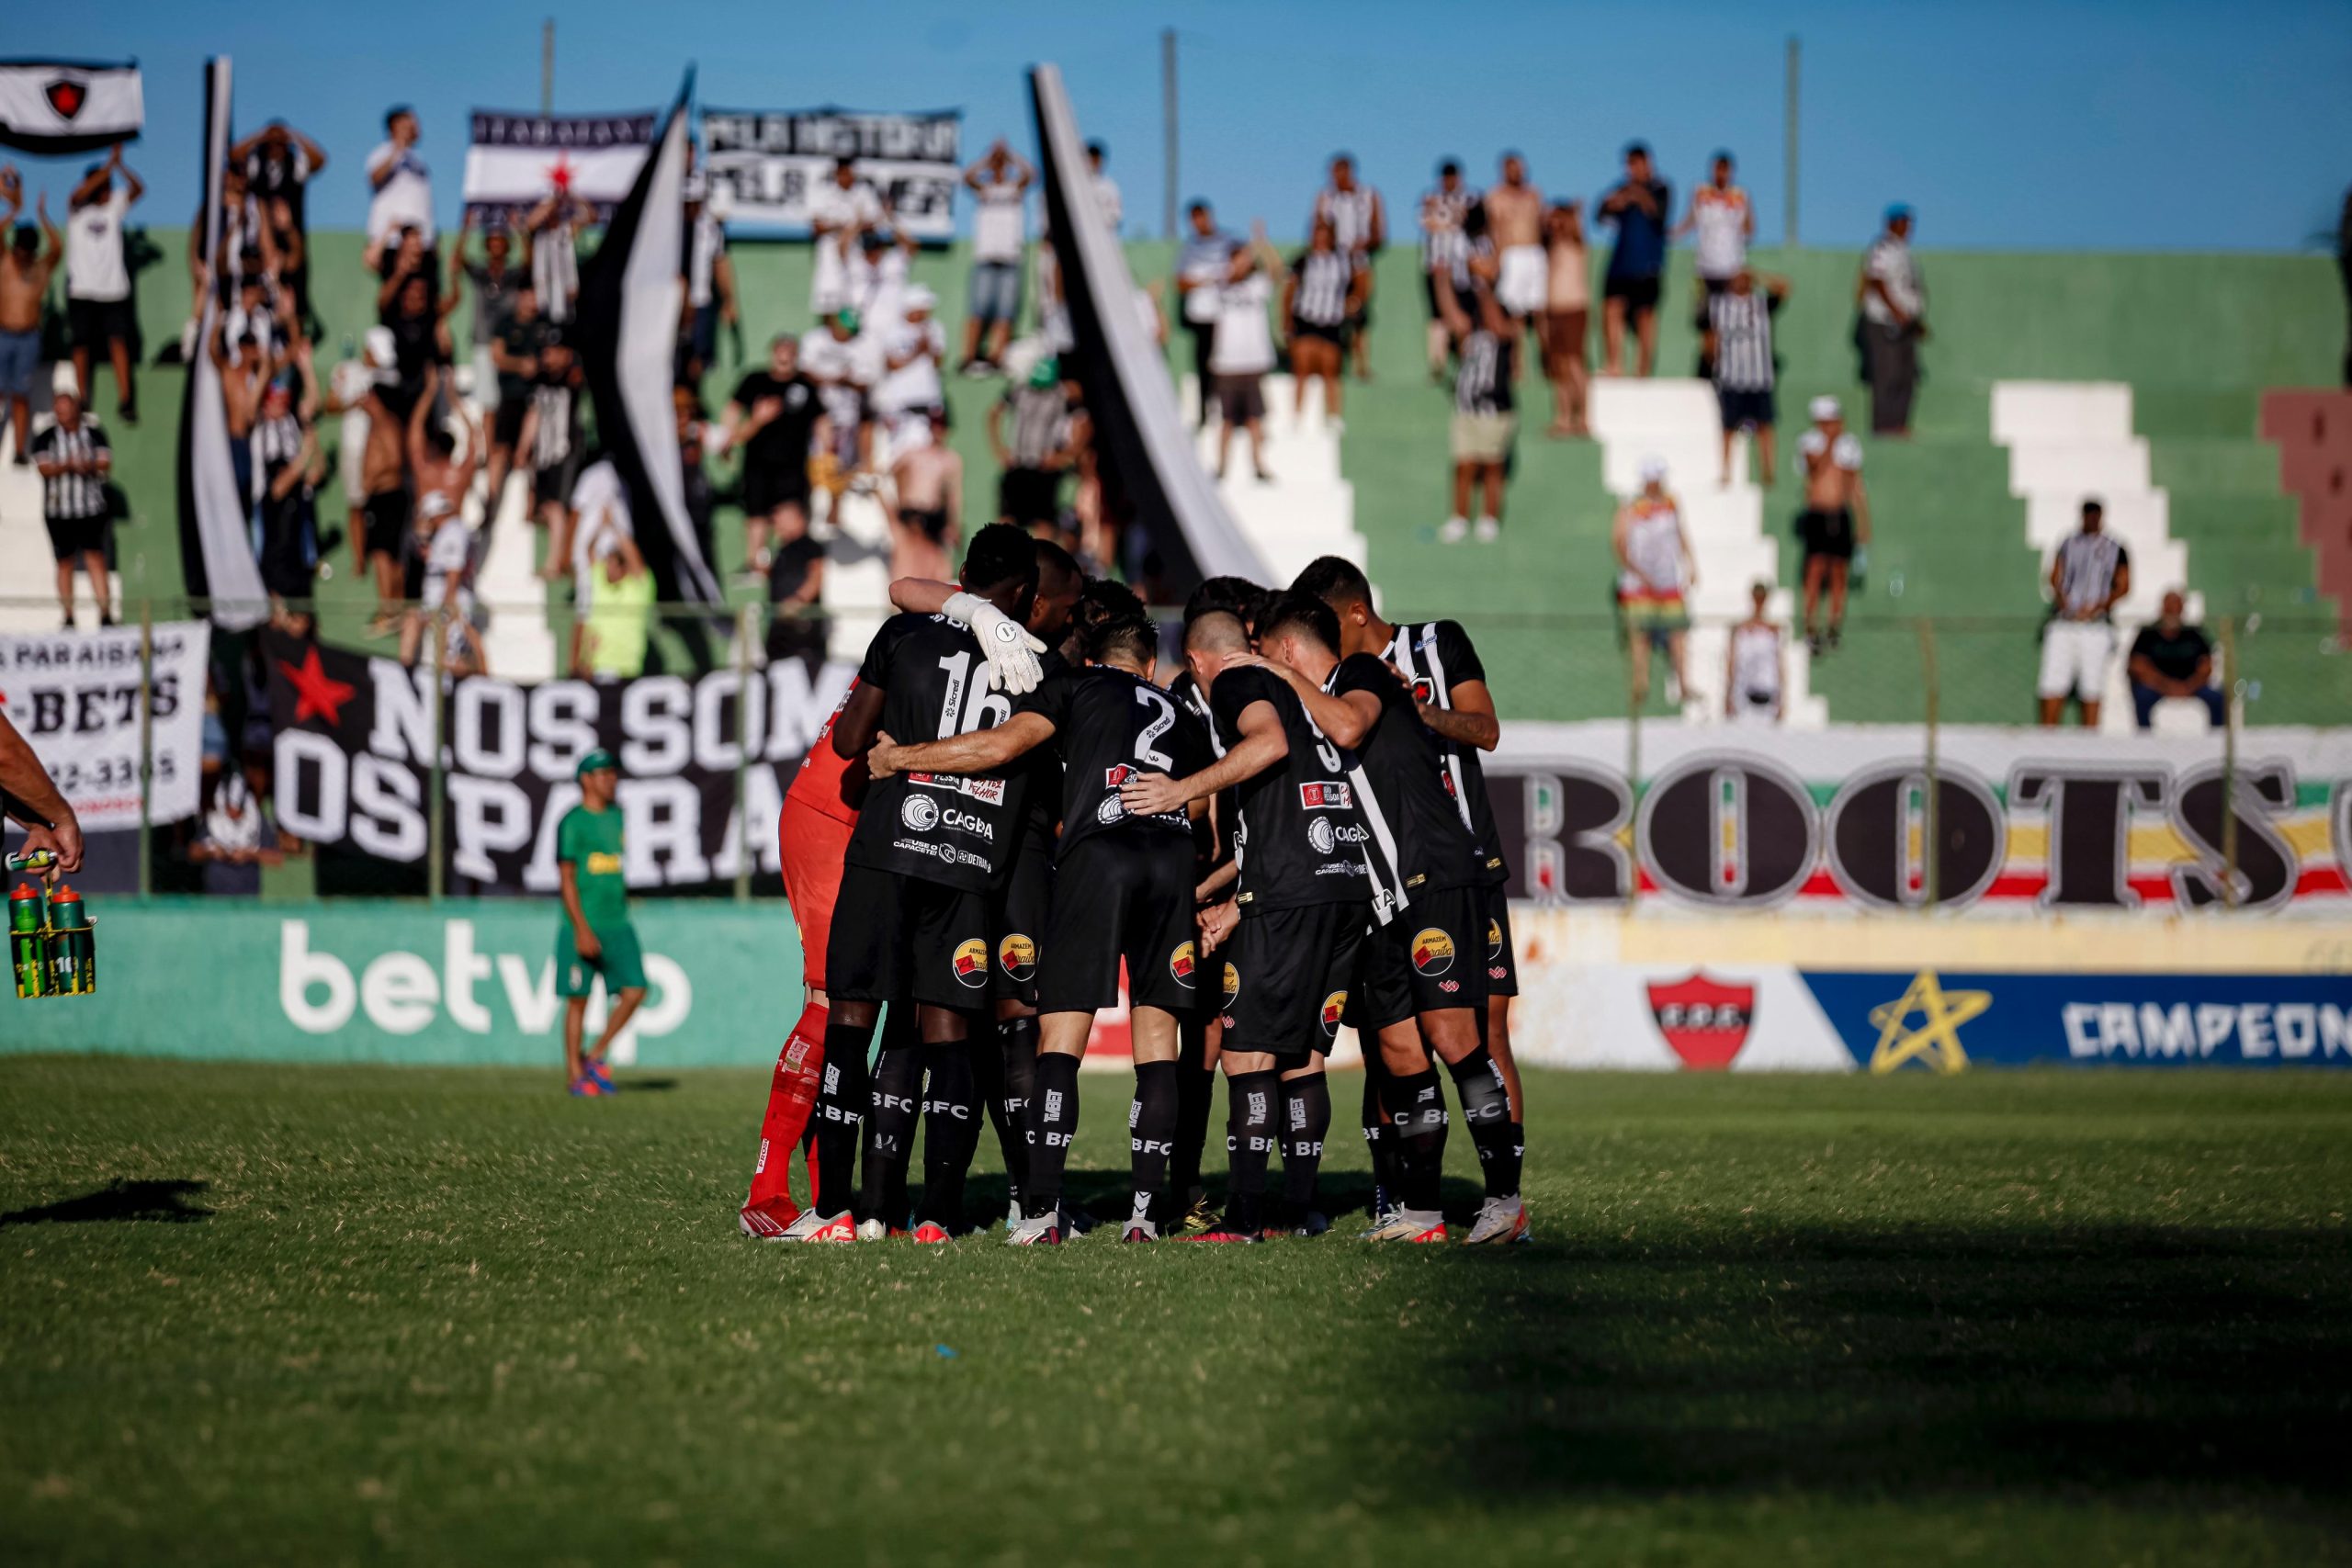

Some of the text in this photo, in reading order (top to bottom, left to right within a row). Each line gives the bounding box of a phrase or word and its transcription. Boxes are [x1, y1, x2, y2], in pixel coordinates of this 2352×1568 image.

[368, 655, 600, 780] NOS
[948, 679, 960, 707] Sicredi
[1135, 685, 1176, 773] 2
[273, 728, 429, 863] OS
[1131, 1137, 1173, 1156] BFC
[1295, 1141, 1324, 1156] BF
